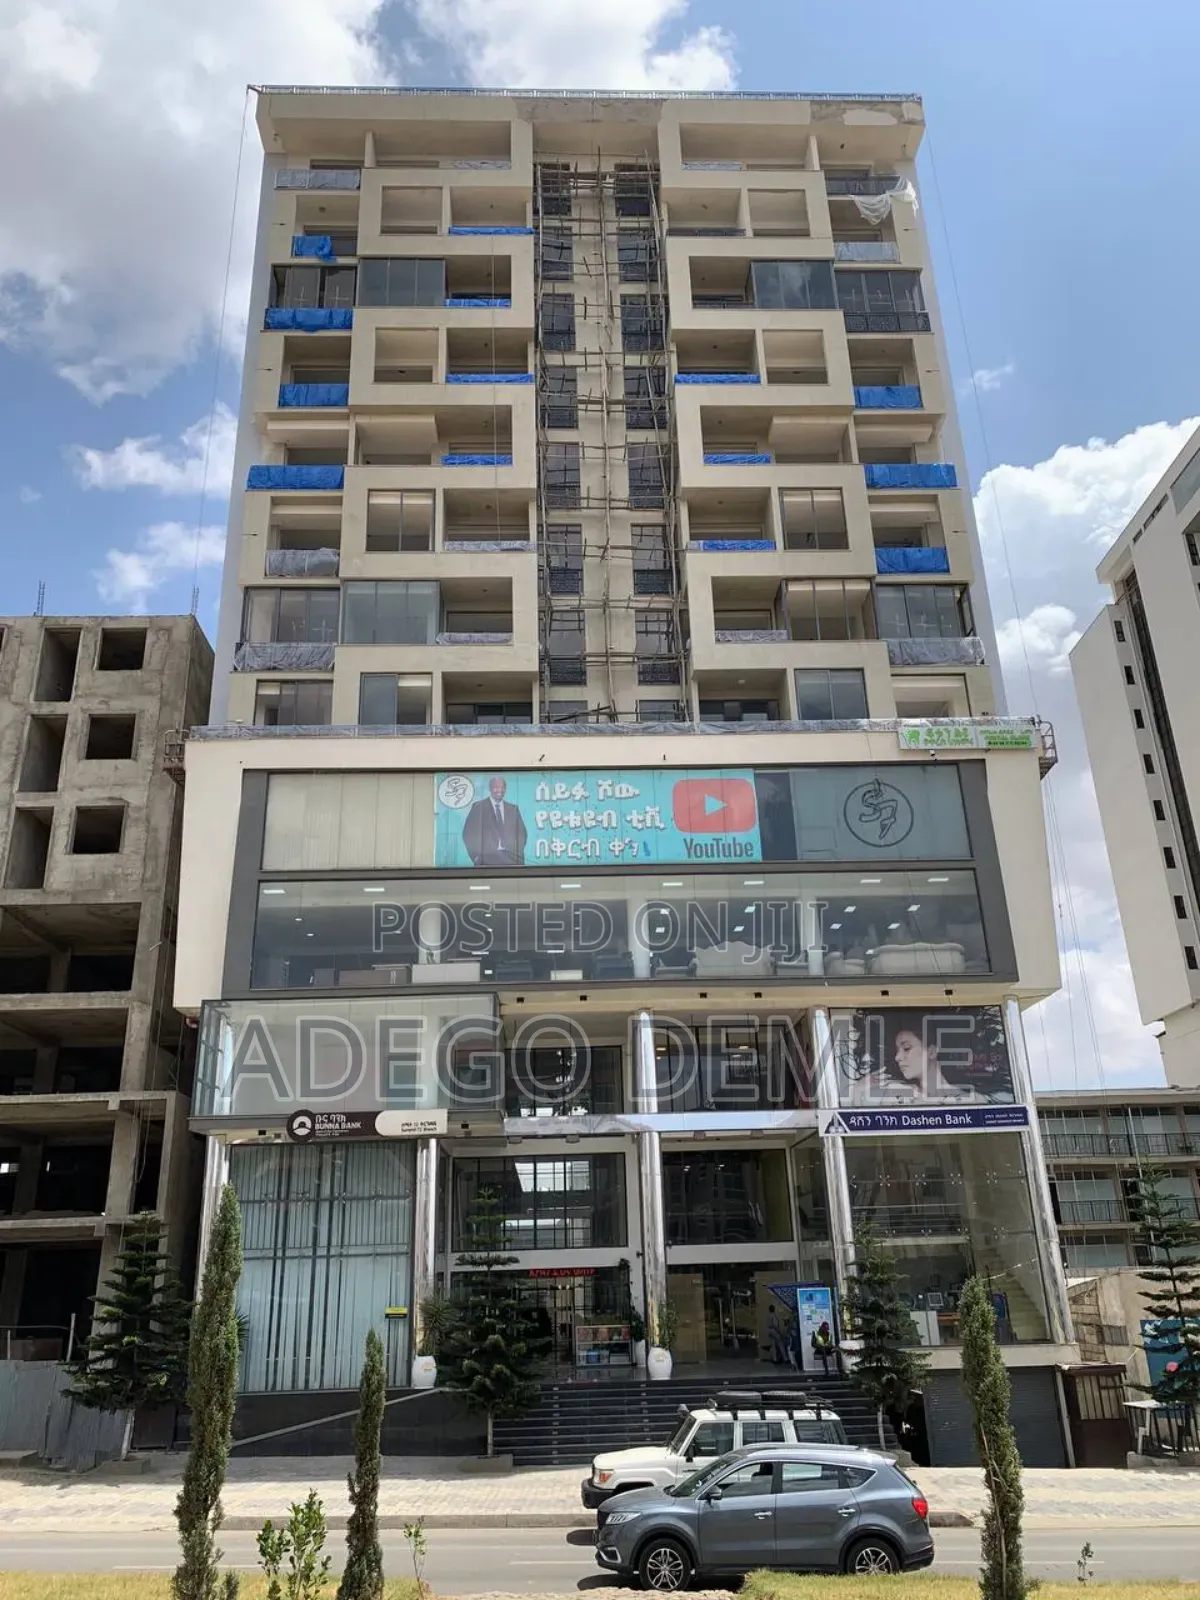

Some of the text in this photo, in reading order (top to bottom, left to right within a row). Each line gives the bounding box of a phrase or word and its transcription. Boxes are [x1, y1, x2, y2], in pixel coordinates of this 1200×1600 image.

[683, 836, 754, 859] YouTube
[341, 1121, 362, 1130] BANK
[902, 1113, 942, 1126] Dashen
[945, 1112, 973, 1125] Bank
